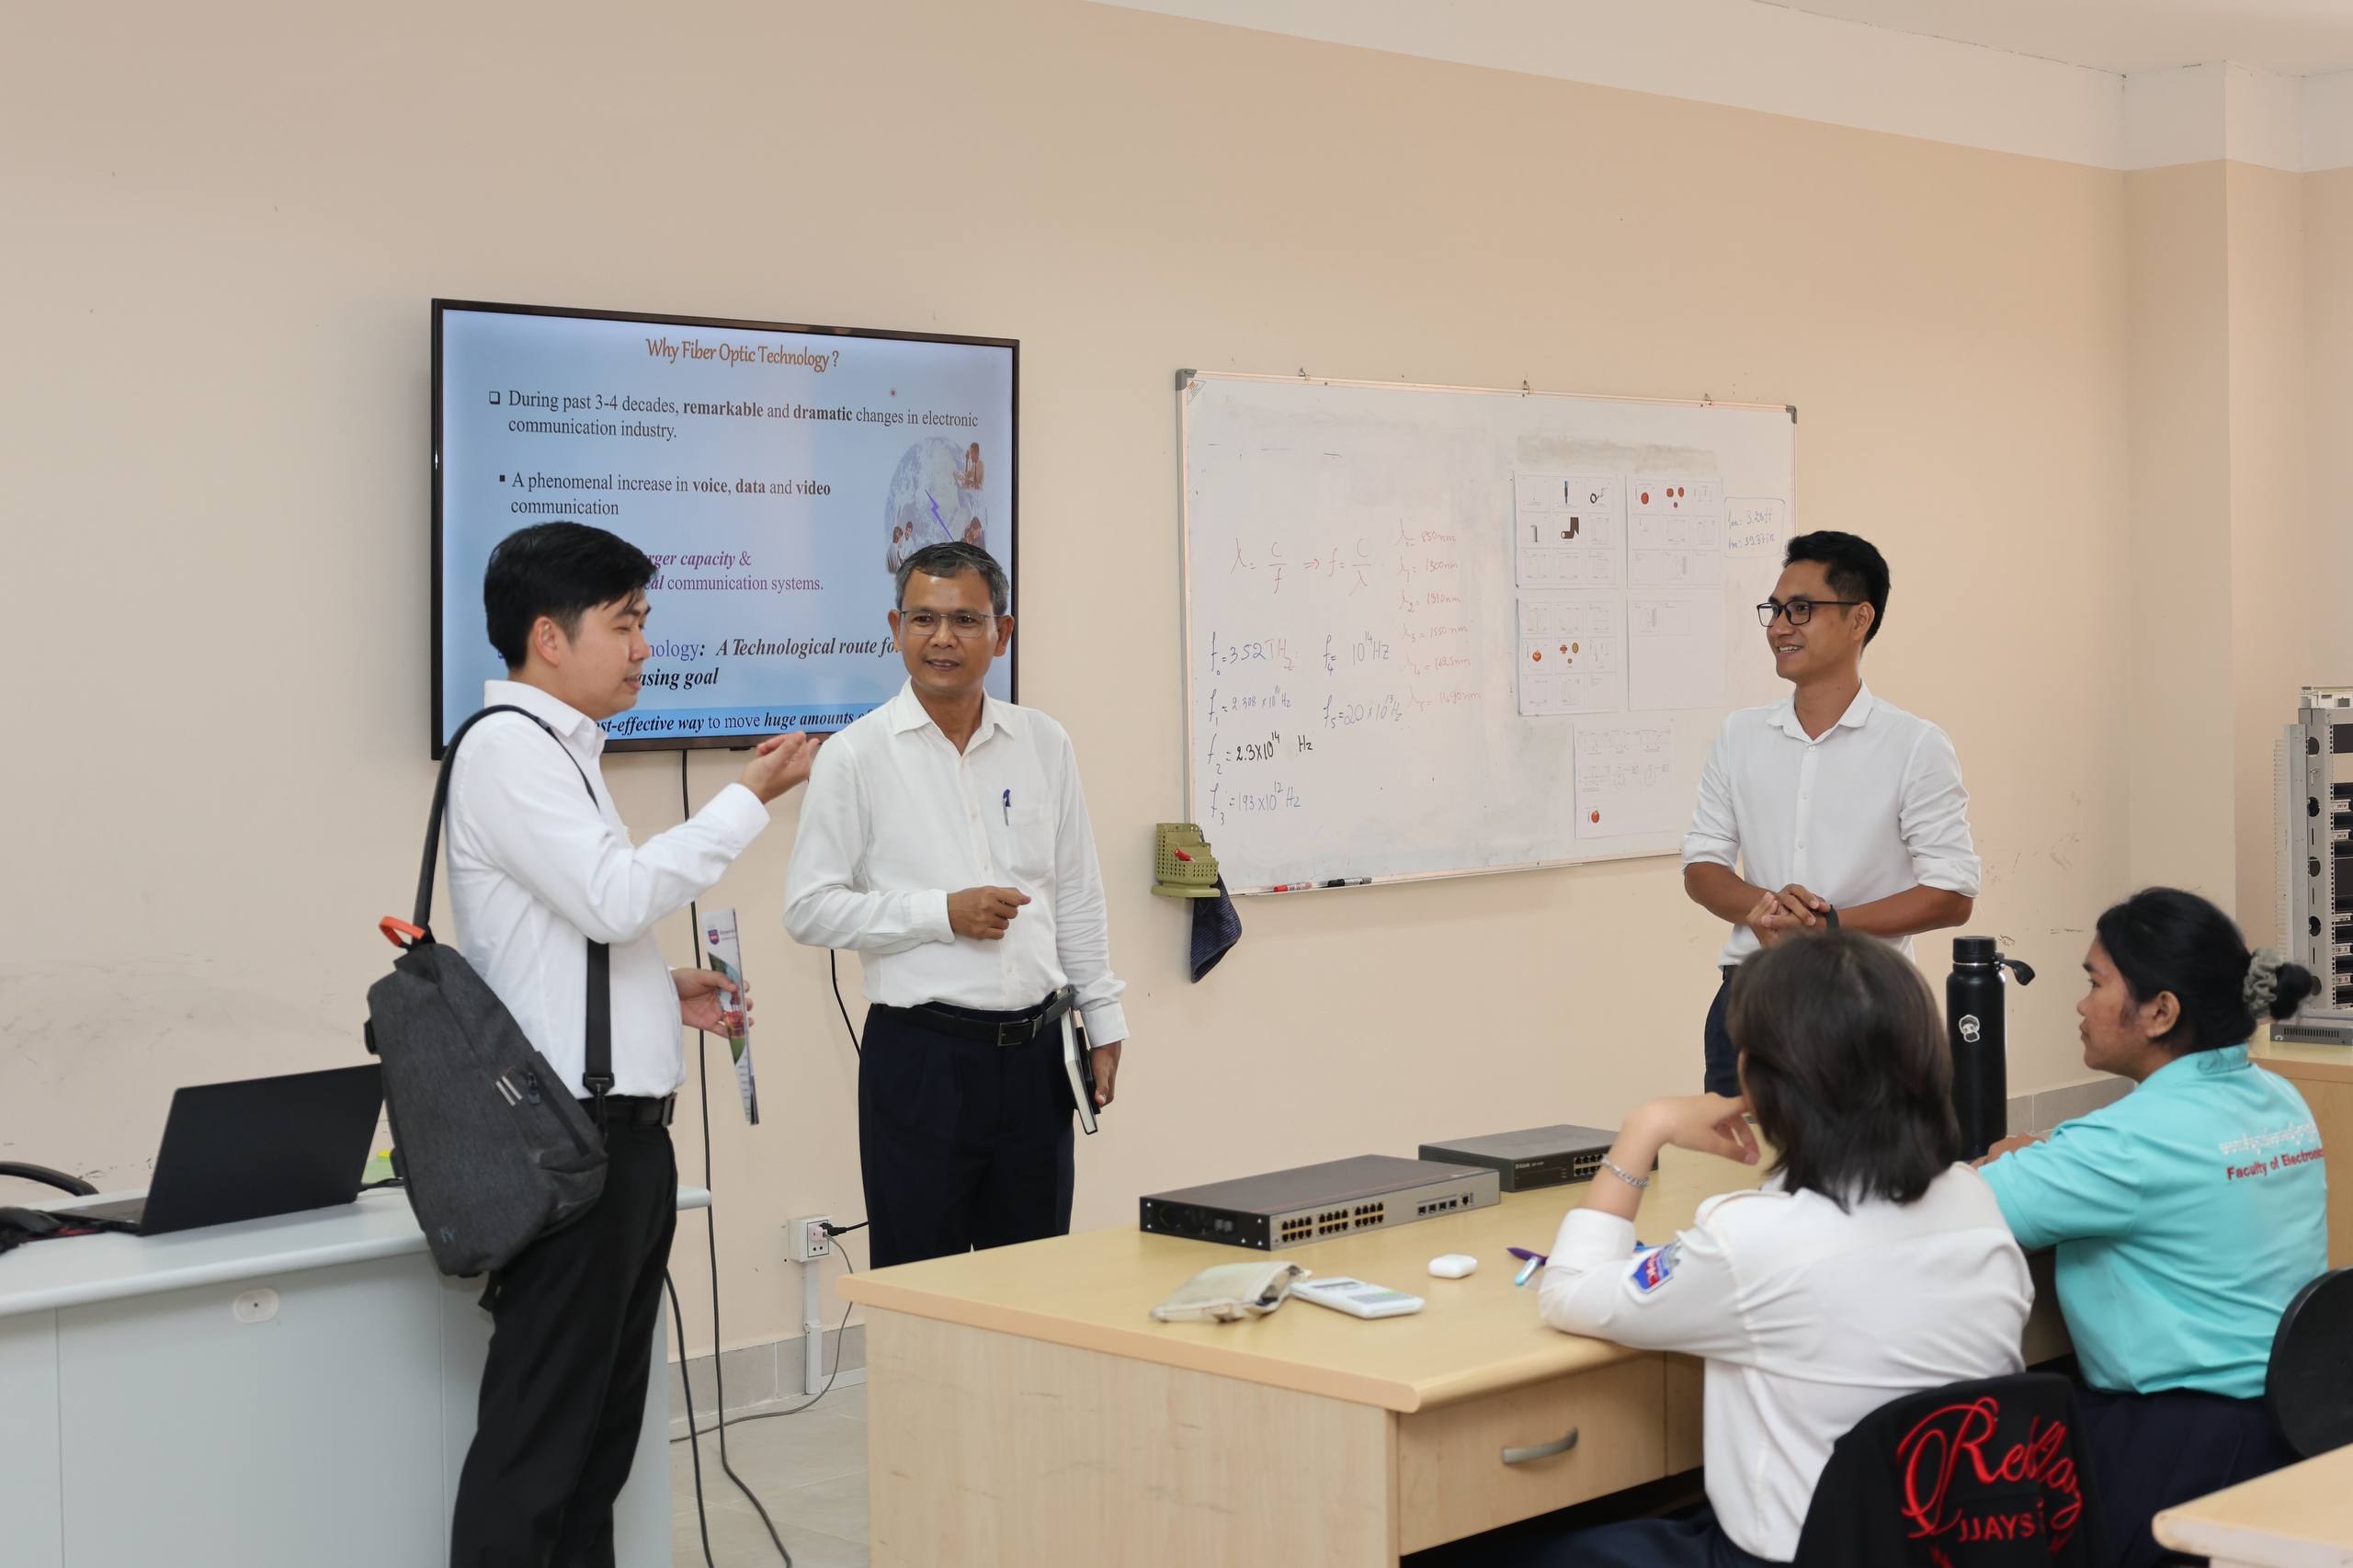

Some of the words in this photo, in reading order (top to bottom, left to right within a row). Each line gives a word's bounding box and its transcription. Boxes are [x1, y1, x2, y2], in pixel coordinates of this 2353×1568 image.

[645, 337, 679, 364] Why
[681, 339, 717, 360] Fiber
[719, 343, 756, 368] Optic
[757, 345, 829, 373] Technology
[508, 390, 559, 412] During
[563, 395, 591, 412] past
[595, 393, 619, 411] 3-4
[621, 395, 679, 416] decades,
[683, 401, 764, 417] remarkable
[767, 403, 790, 418] and
[793, 403, 853, 421] dramatic
[856, 407, 904, 426] changes
[907, 408, 918, 425] in
[922, 410, 979, 427] electronic
[508, 418, 617, 436] communication
[620, 420, 677, 442] industry.
[511, 472, 525, 488] A
[528, 472, 613, 493] phenomenal
[617, 474, 672, 492] increase
[676, 476, 688, 492] in
[692, 478, 732, 495] voice,
[735, 478, 766, 494] data
[769, 480, 792, 494] and
[796, 480, 831, 495] video
[511, 498, 620, 515] communication
[680, 551, 735, 569] capacity
[739, 551, 752, 566] &
[667, 574, 767, 590] communication
[771, 576, 824, 594] systems.
[715, 639, 728, 656] A
[733, 637, 836, 660] Technological
[839, 639, 877, 654] route
[878, 636, 899, 658] fo
[683, 667, 720, 690] goal
[678, 717, 705, 733] way
[708, 715, 721, 729] to
[724, 715, 760, 729] move
[764, 712, 797, 730] huge
[800, 711, 854, 726] amounts
[2226, 1161, 2267, 1181] Faculty
[2270, 1155, 2279, 1170] of
